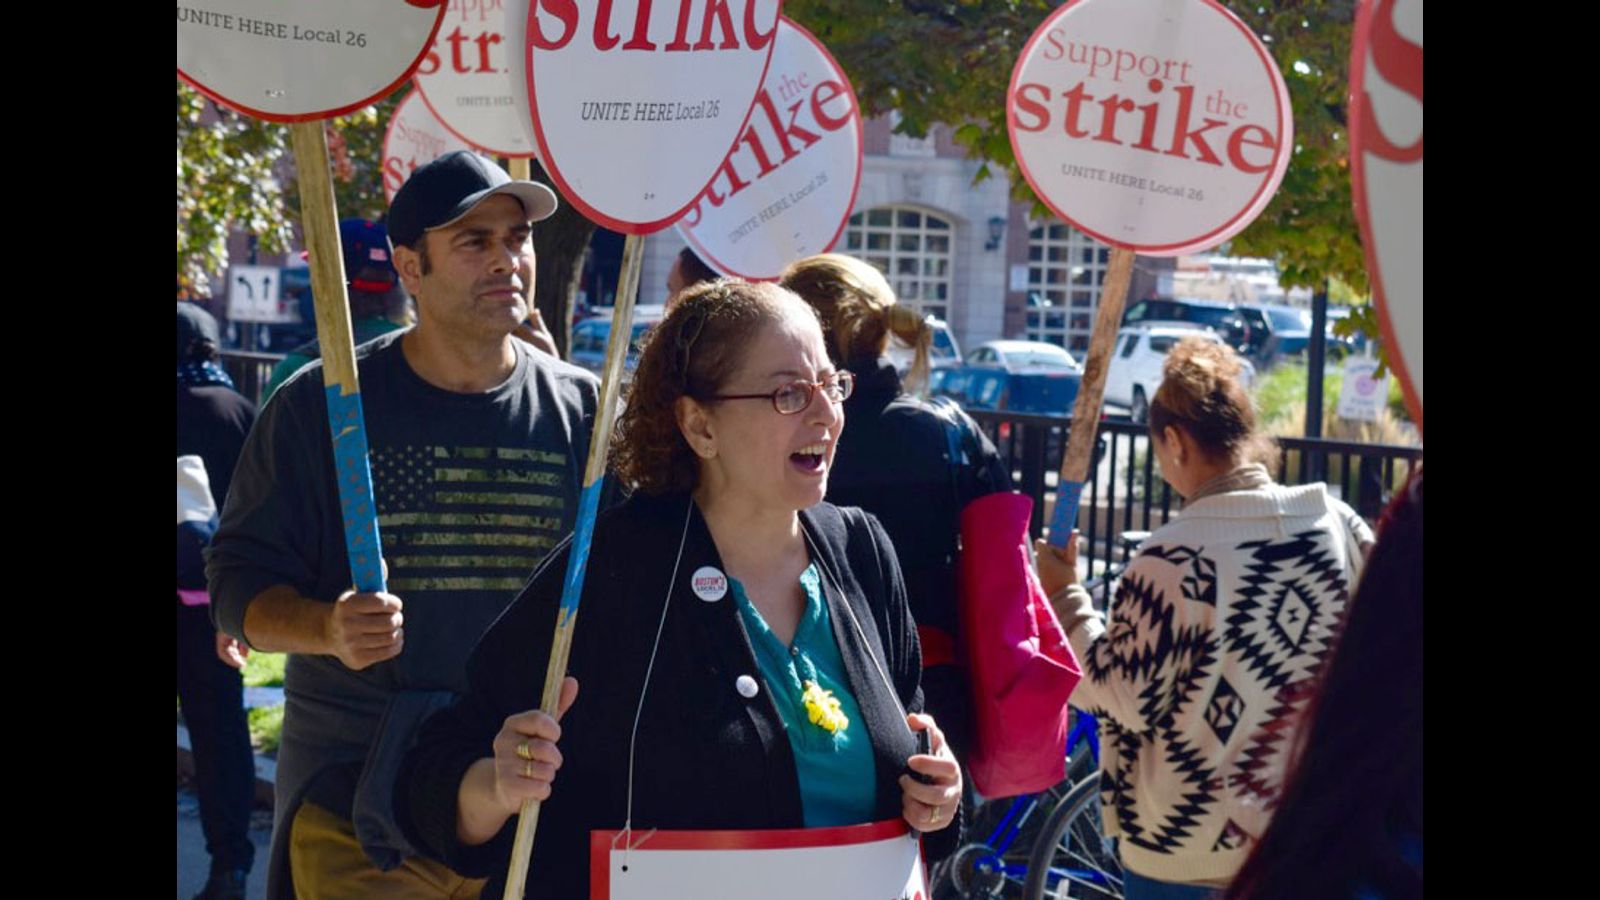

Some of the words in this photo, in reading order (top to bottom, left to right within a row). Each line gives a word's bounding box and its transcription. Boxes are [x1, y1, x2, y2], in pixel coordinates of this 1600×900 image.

[177, 7, 233, 29] UNITE
[238, 17, 288, 39] HERE
[293, 25, 341, 43] Local
[345, 31, 367, 48] 26
[1043, 27, 1193, 83] Support
[777, 71, 811, 101] the
[1205, 89, 1248, 118] the
[581, 101, 632, 121] UNITE
[633, 102, 675, 121] HERE
[675, 101, 705, 120] Local
[706, 99, 720, 118] 26
[1013, 78, 1278, 174] strike
[1061, 163, 1107, 182] UNITE
[1109, 171, 1147, 190] HERE
[1149, 180, 1185, 197] Local
[1187, 187, 1205, 201] 26
[728, 215, 760, 244] UNITE
[759, 196, 792, 223] HERE
[788, 179, 816, 204] Local
